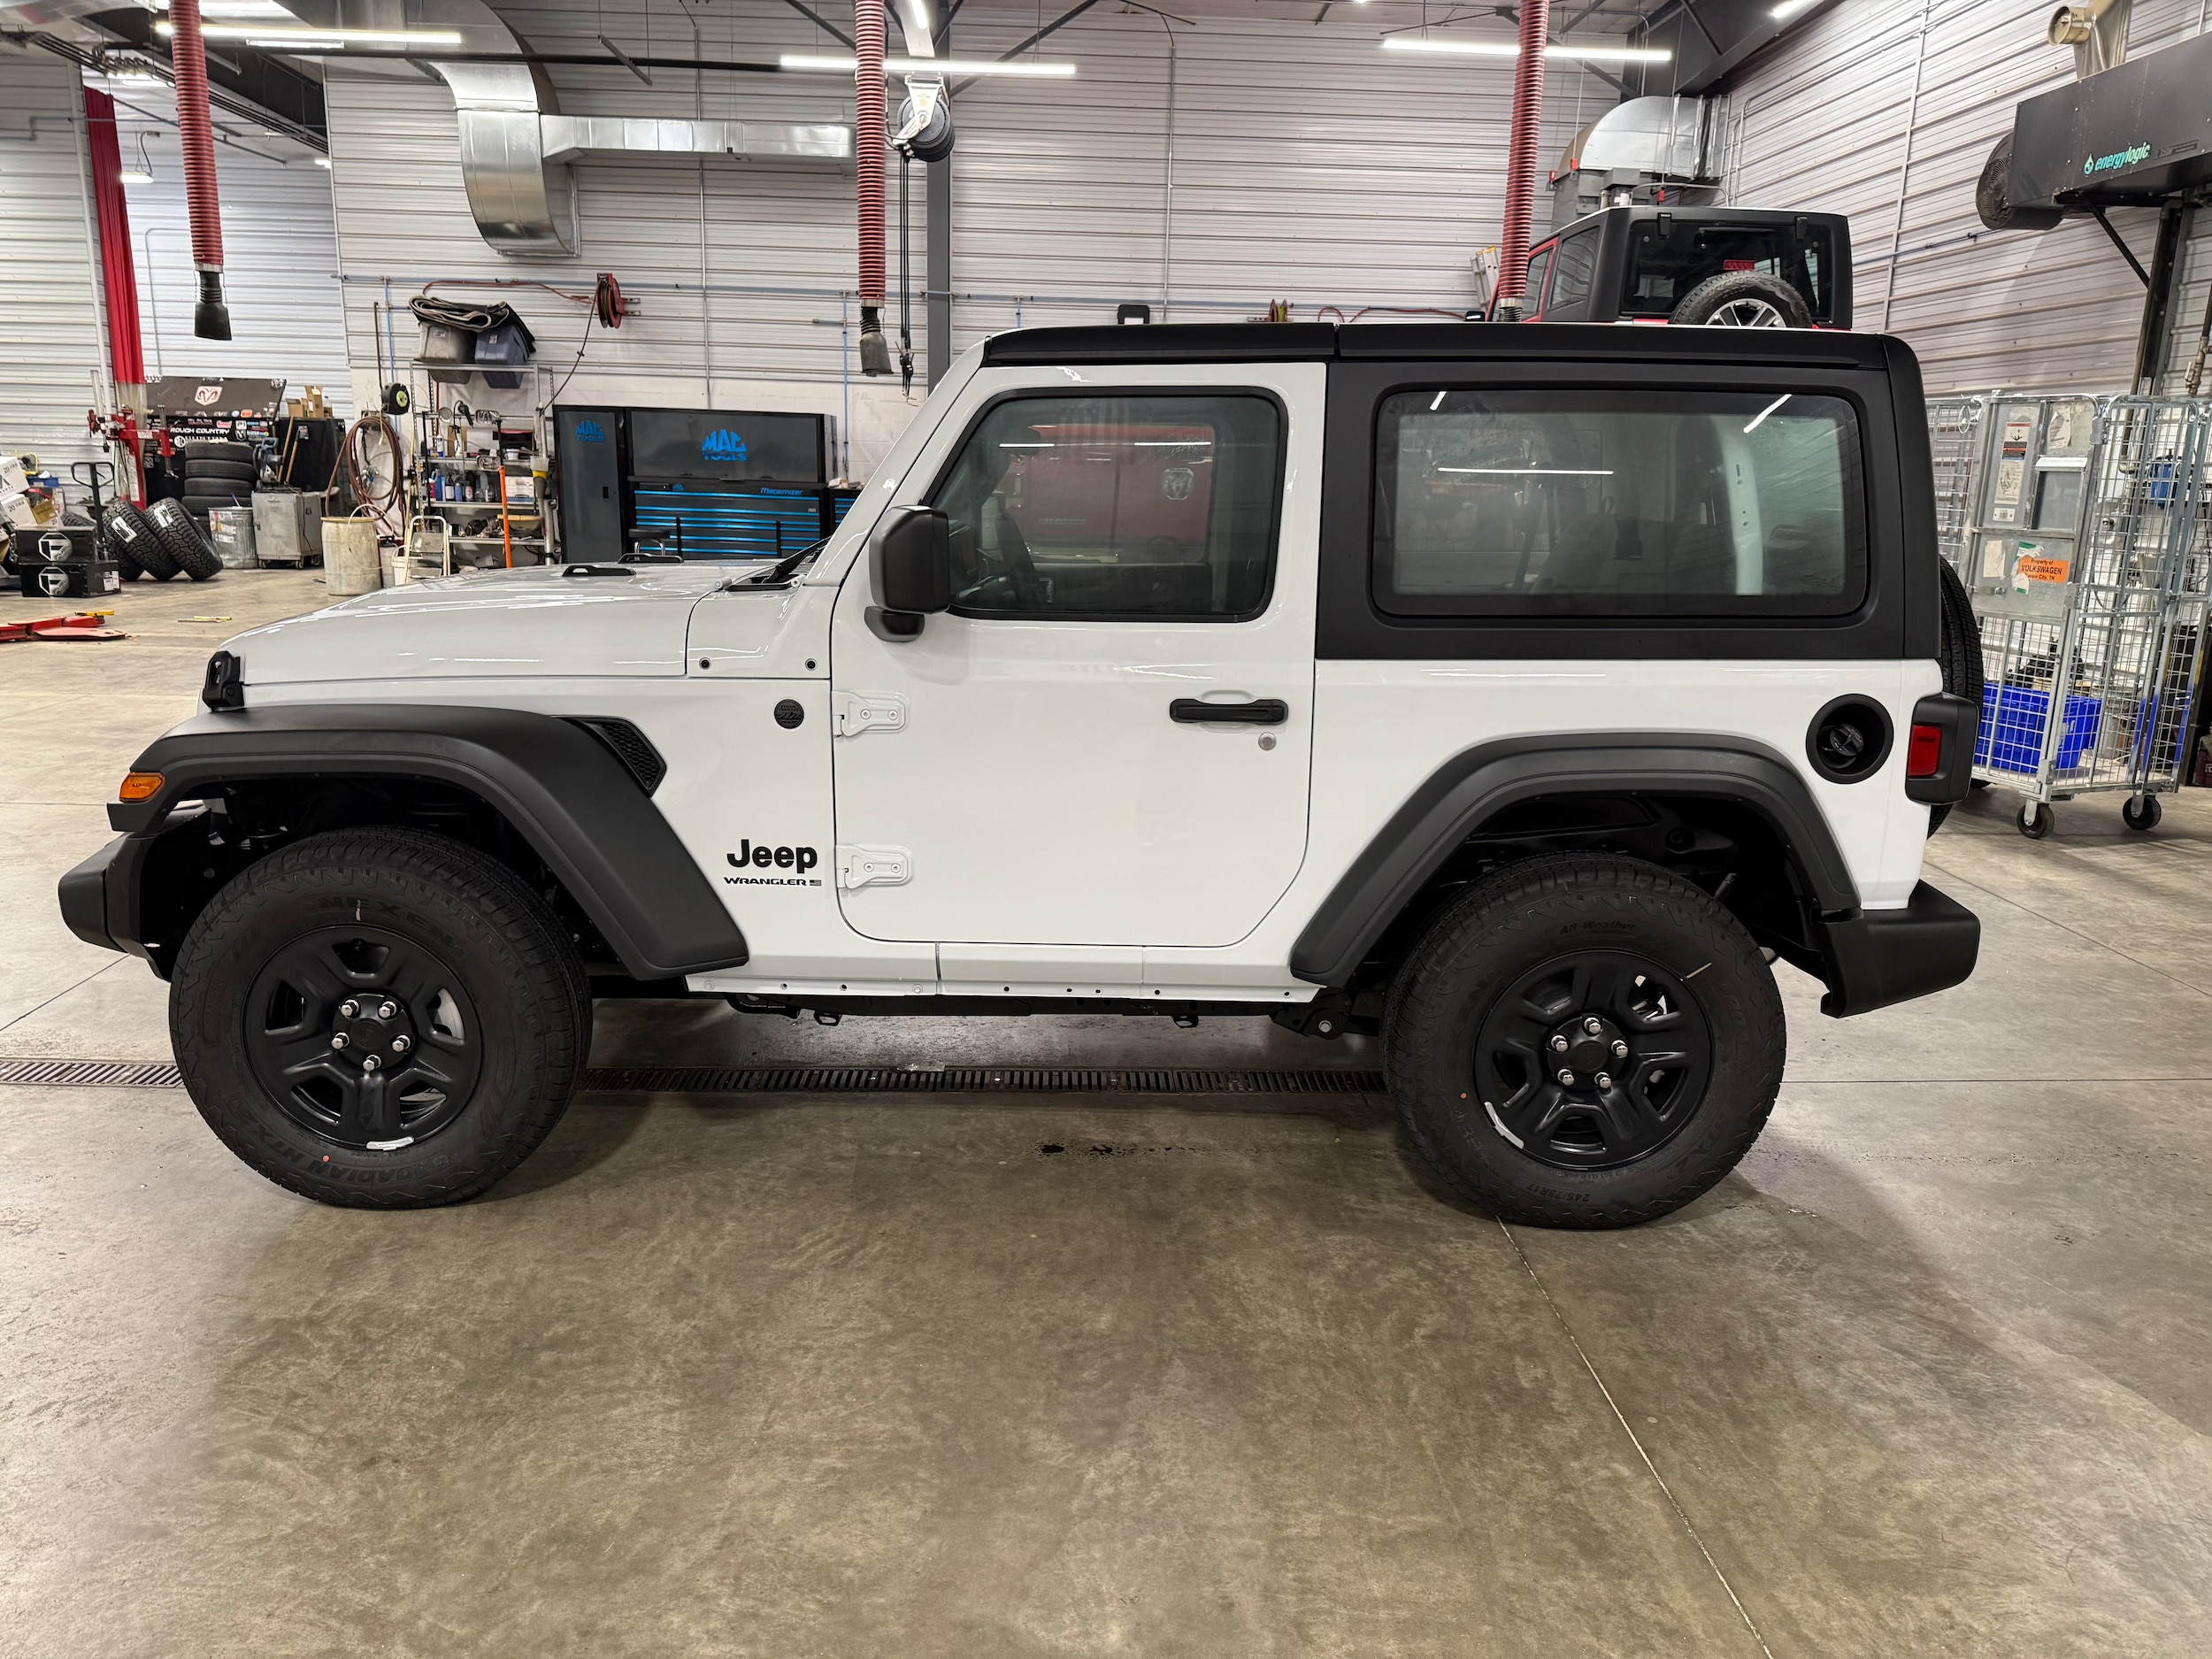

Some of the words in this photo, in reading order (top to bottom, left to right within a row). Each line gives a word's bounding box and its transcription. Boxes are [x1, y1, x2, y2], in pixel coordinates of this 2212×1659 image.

[2094, 142, 2151, 172] energylogic
[575, 419, 604, 435] MAC
[702, 428, 748, 452] MAC
[703, 452, 748, 462] TOOLS
[7, 503, 15, 512] 20
[2021, 565, 2062, 575] VOLKSWAGEN
[726, 839, 818, 874] Jeep
[723, 877, 807, 886] WRANGLER
[318, 896, 454, 946] NEXEN
[1525, 1182, 1591, 1202] 245/75R17
